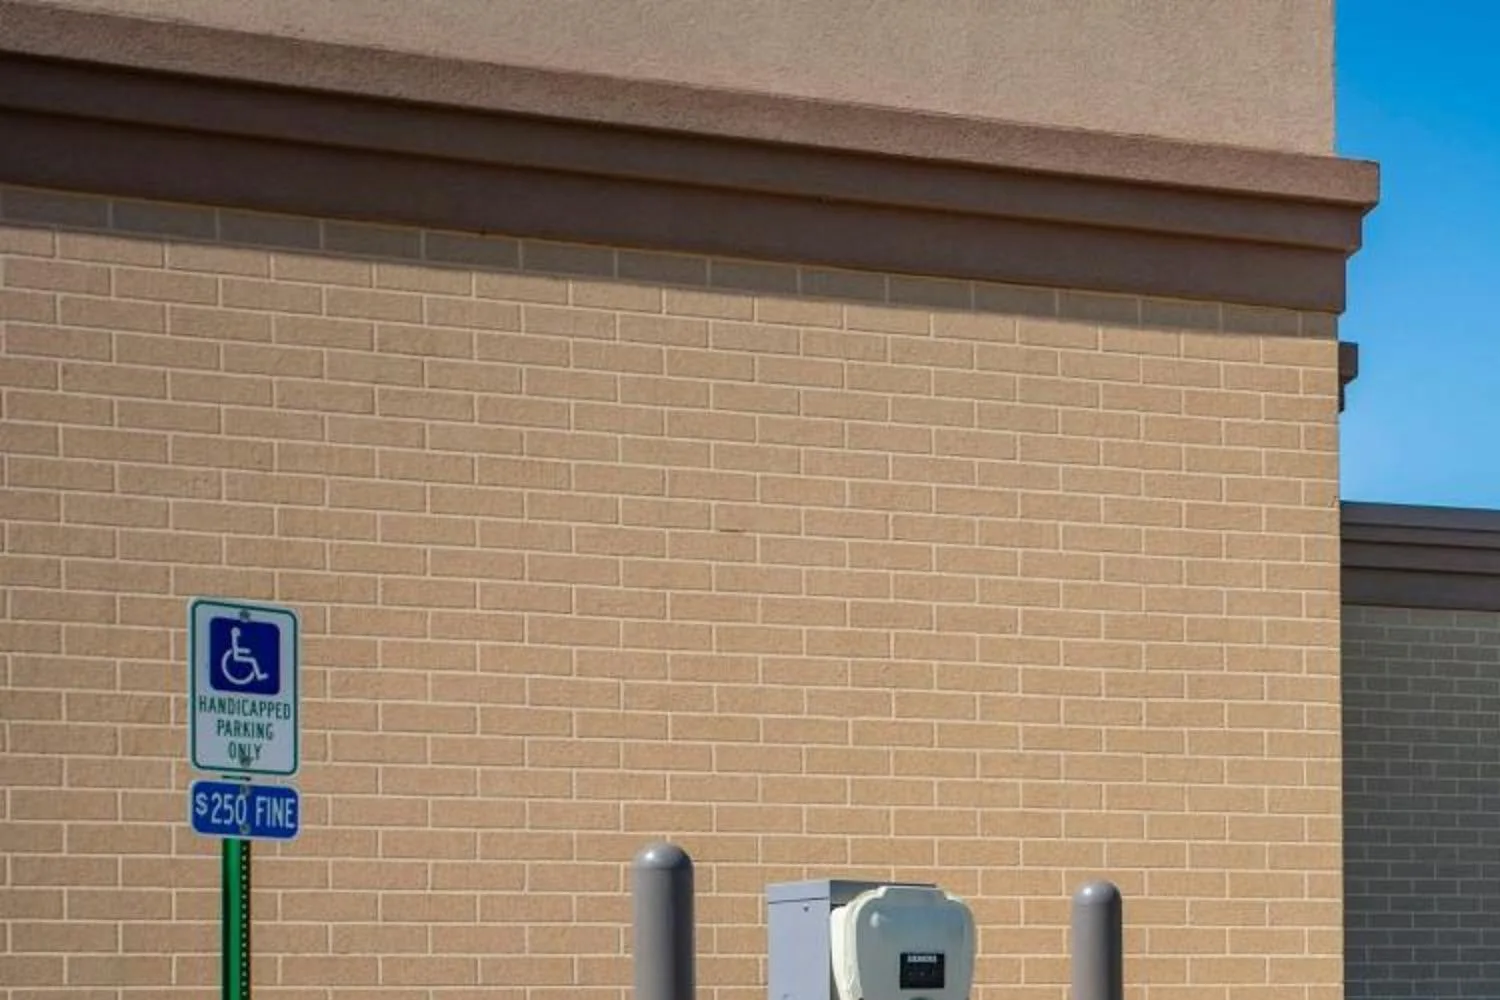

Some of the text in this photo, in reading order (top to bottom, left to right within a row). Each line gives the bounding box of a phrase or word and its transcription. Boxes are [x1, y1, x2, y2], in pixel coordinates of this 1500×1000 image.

[199, 695, 291, 720] HANDICAPPED
[216, 719, 274, 740] PARKING
[228, 741, 262, 761] ONLY
[195, 792, 296, 829] $250 FINE
